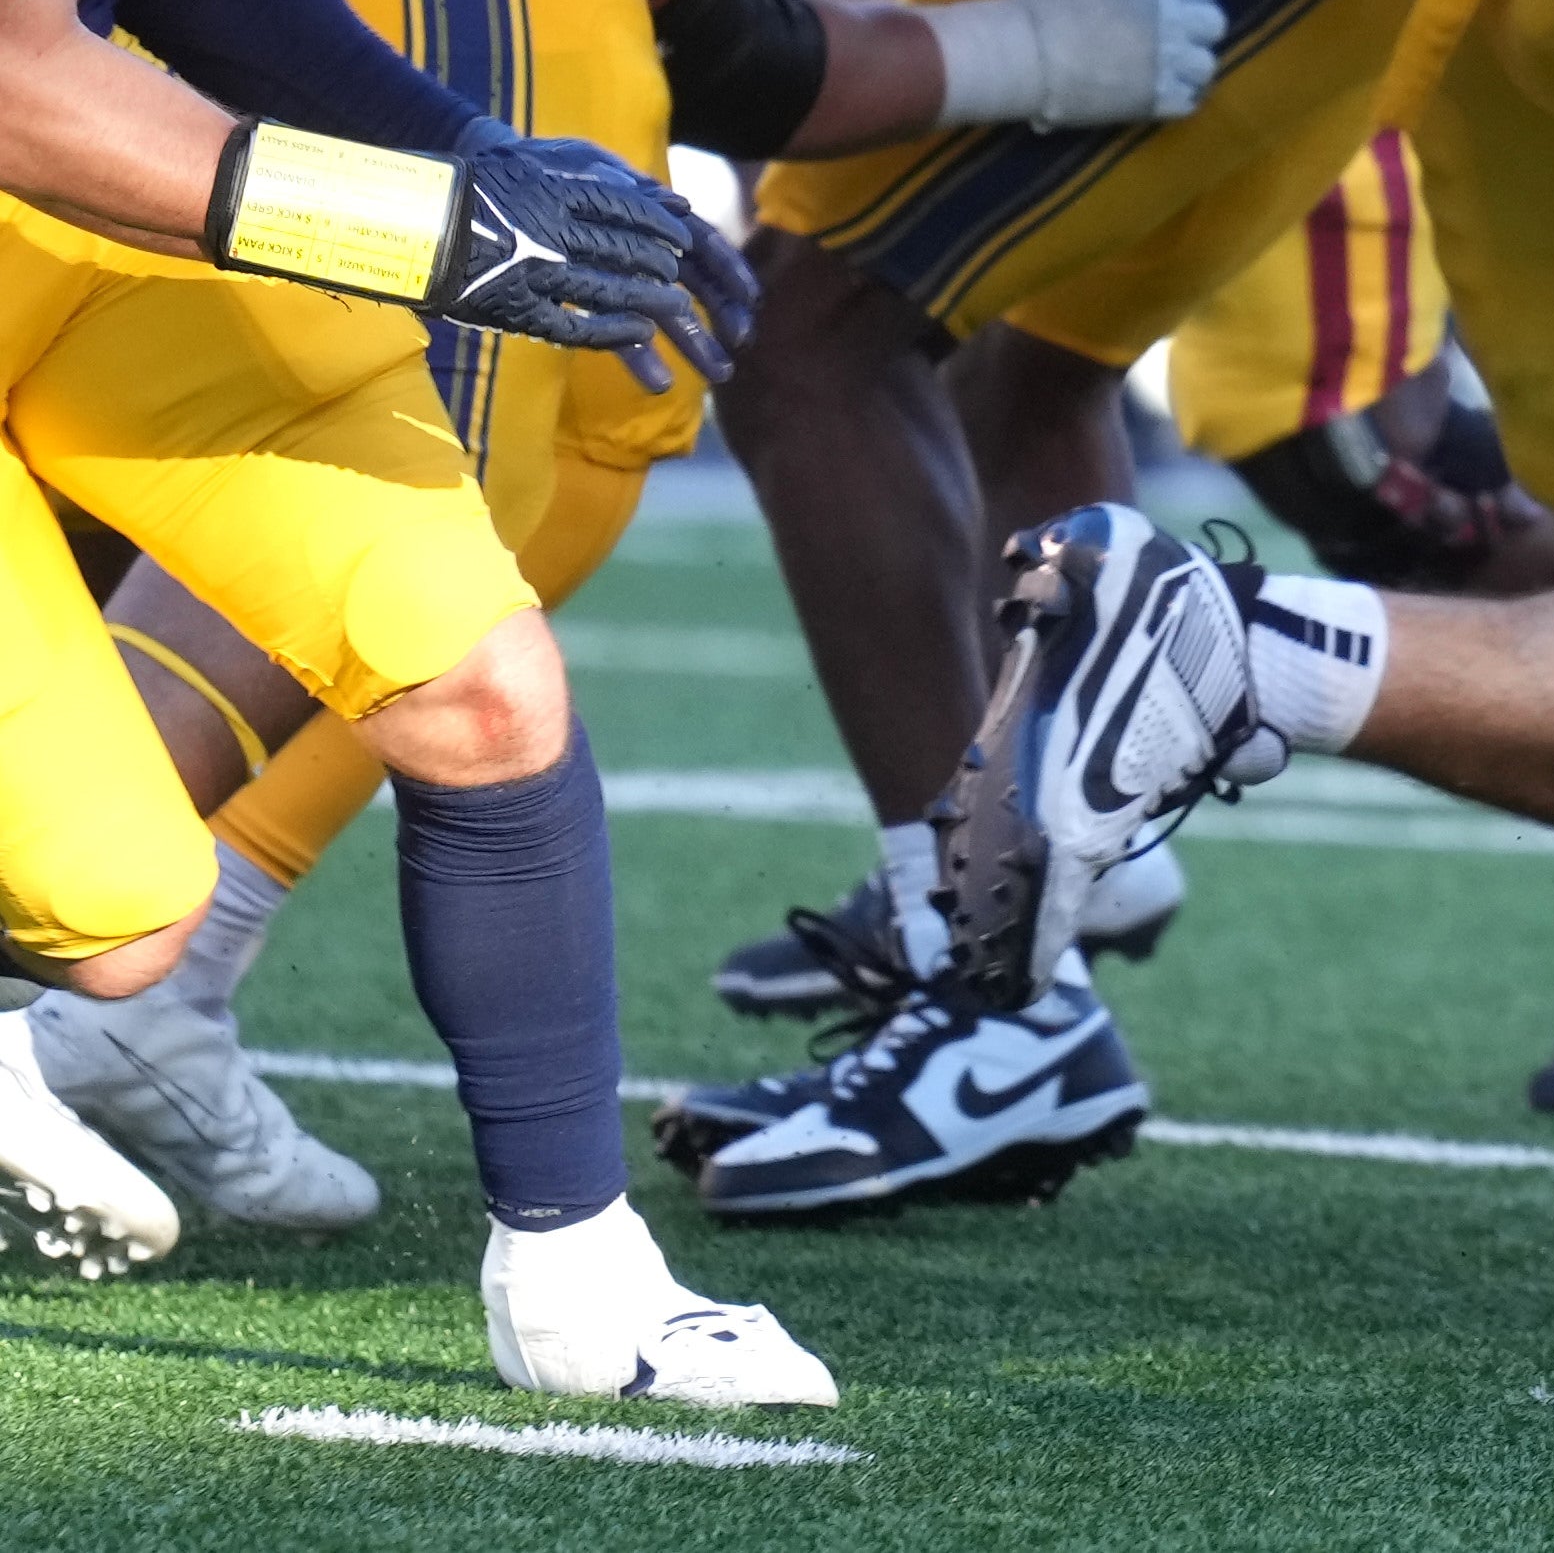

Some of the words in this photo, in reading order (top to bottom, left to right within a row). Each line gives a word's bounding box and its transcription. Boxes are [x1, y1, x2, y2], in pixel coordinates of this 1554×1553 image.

[278, 208, 302, 221] KICK
[237, 235, 266, 251] PAM
[269, 241, 293, 255] KICK
